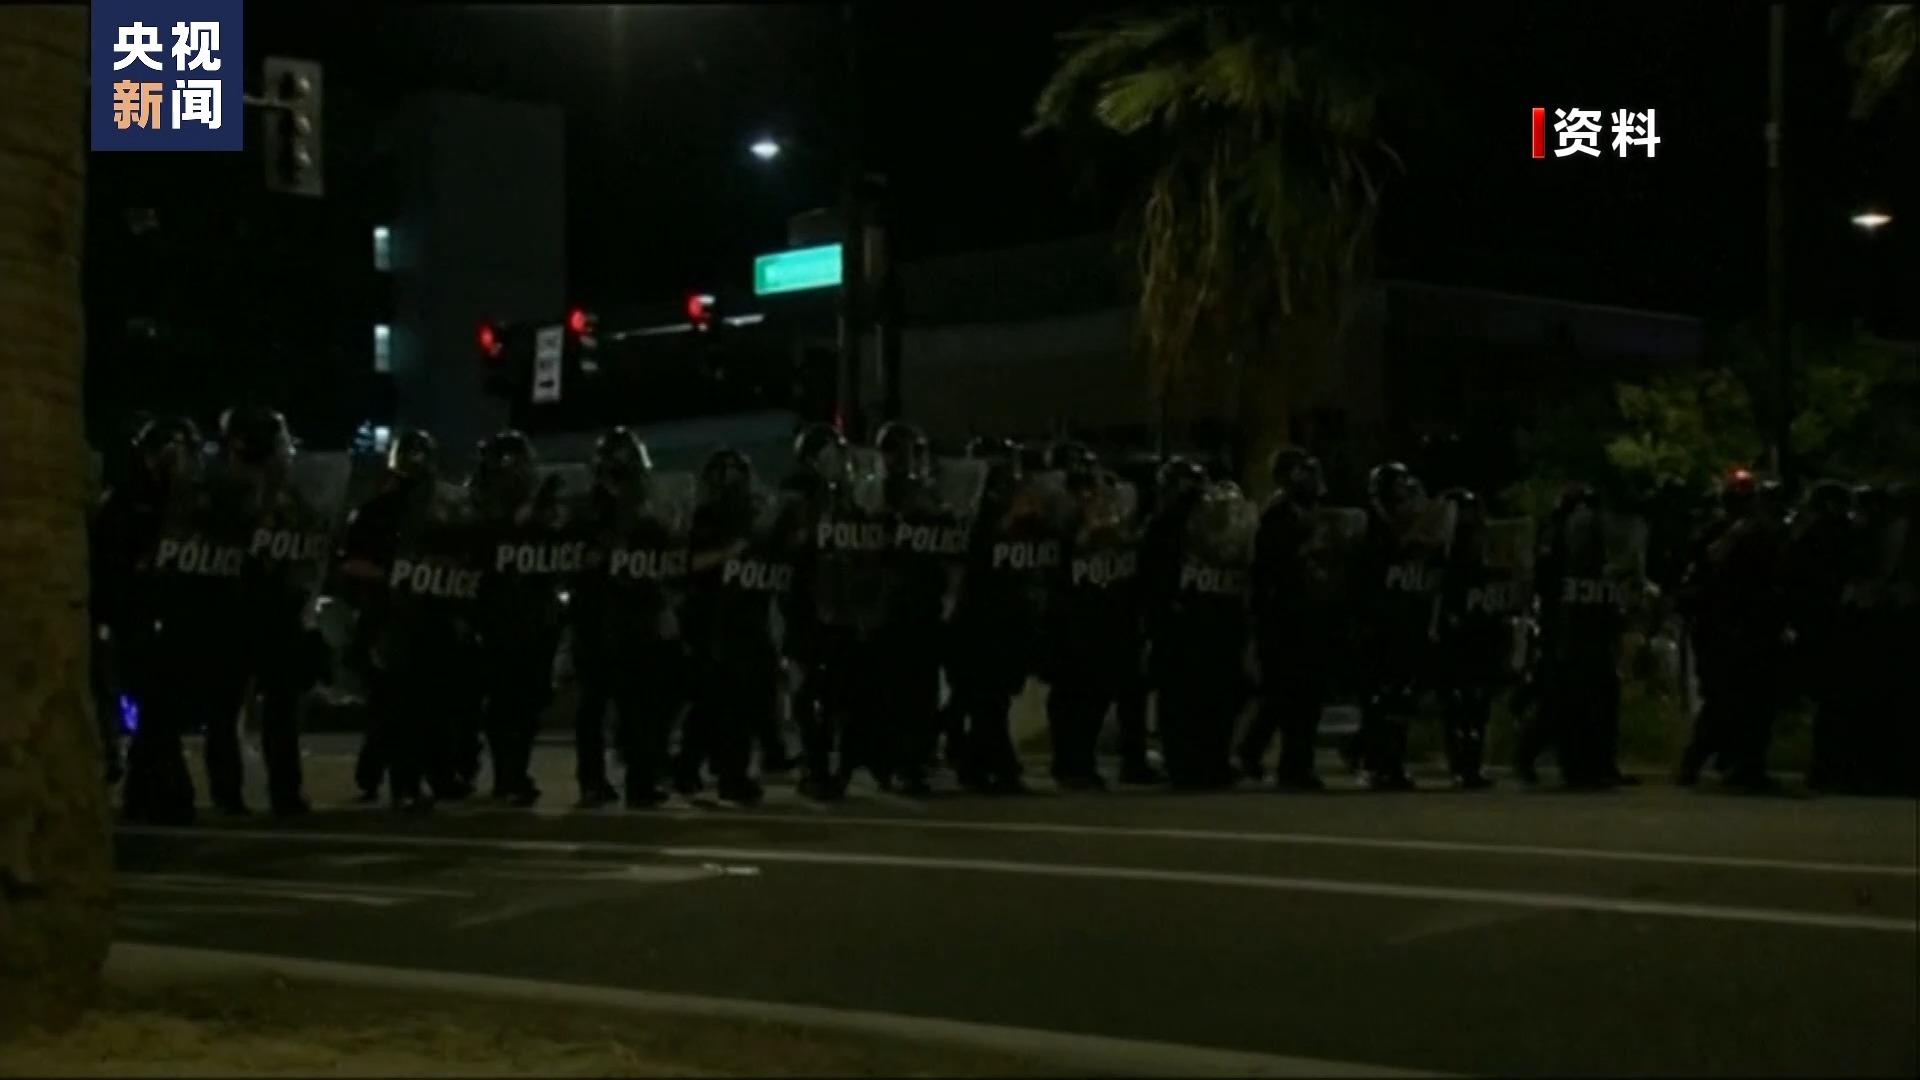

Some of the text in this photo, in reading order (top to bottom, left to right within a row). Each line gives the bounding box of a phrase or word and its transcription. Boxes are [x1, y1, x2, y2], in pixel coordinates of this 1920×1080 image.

[815, 522, 885, 549] POLIC
[155, 537, 243, 575] POLIC
[721, 558, 793, 591] POLIC
